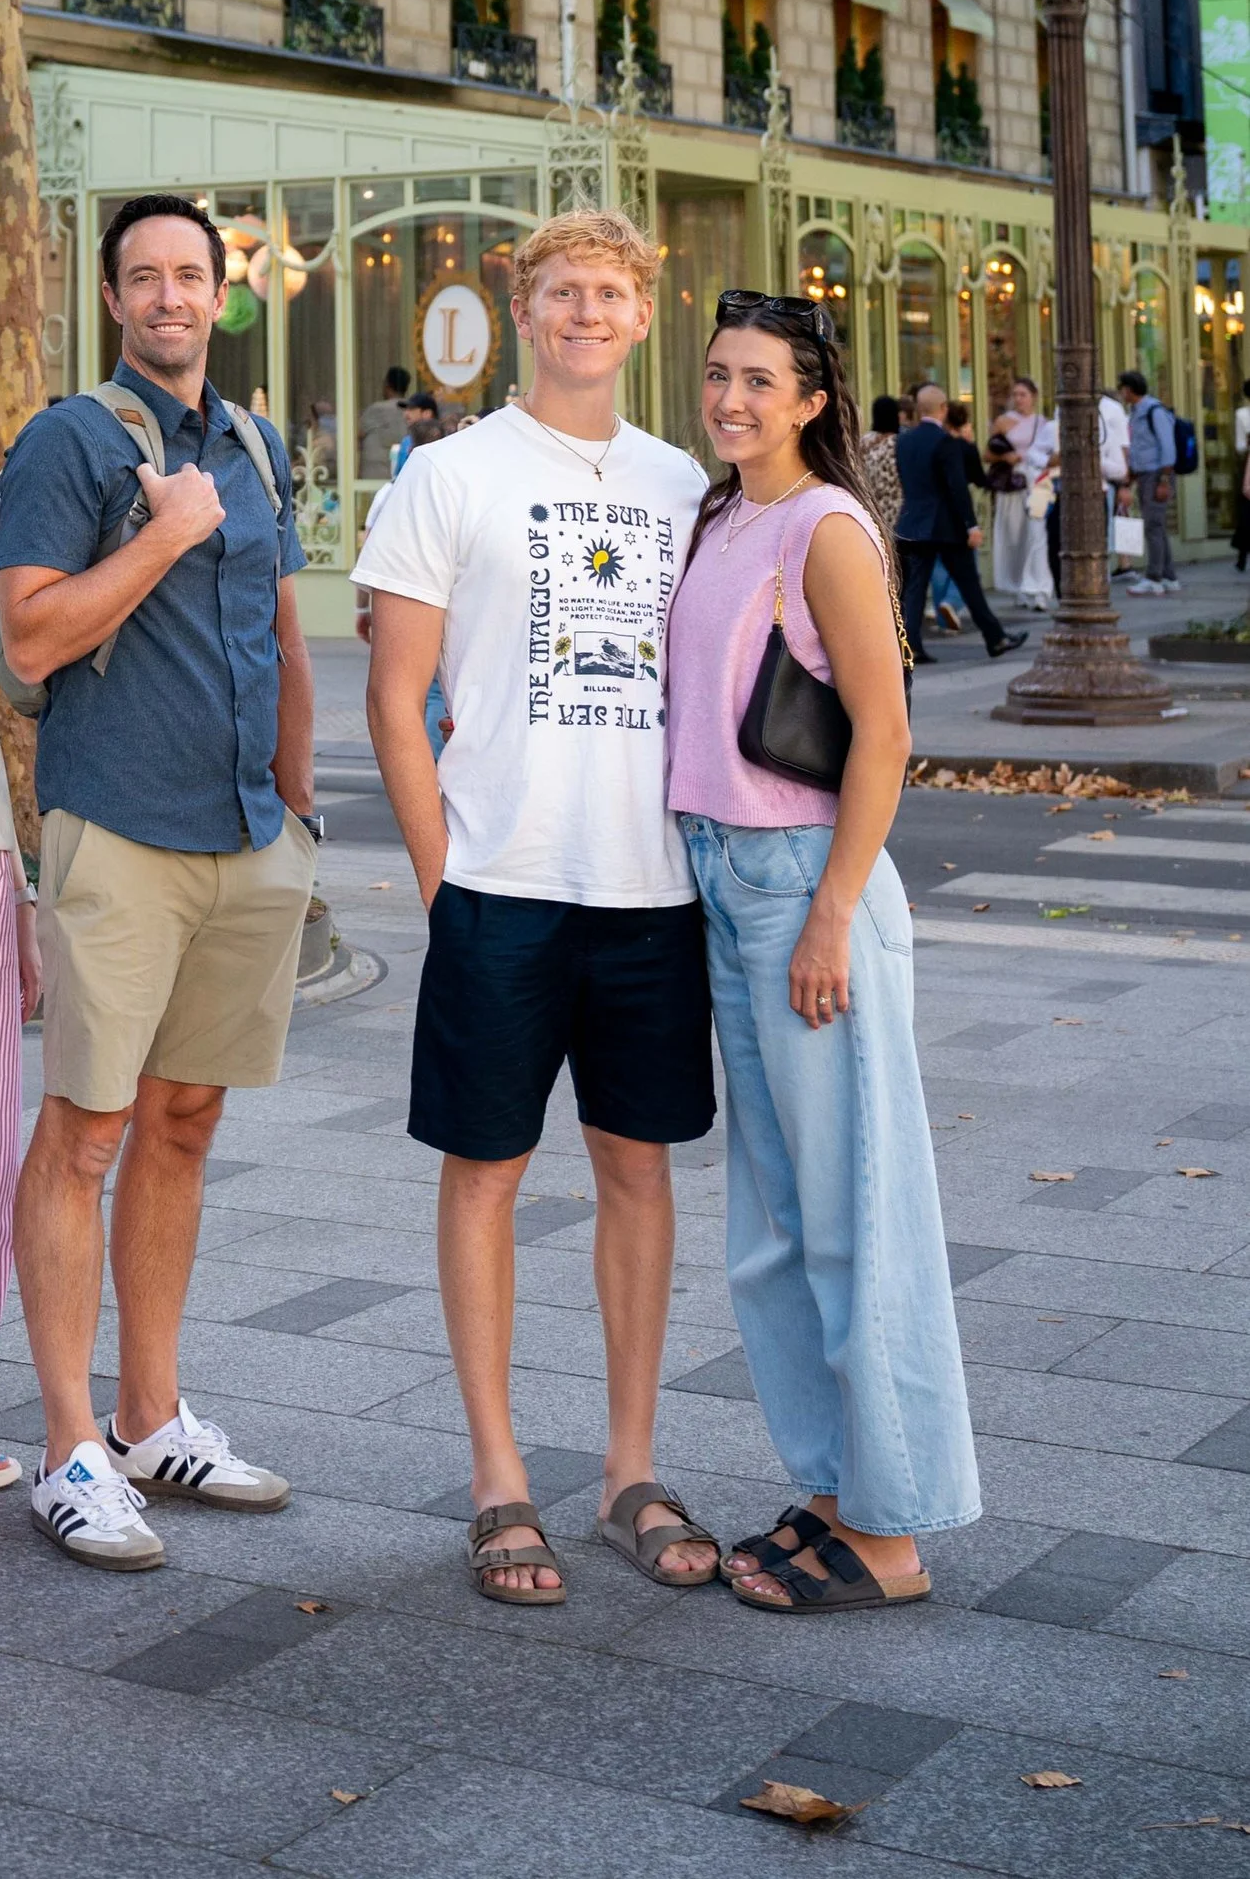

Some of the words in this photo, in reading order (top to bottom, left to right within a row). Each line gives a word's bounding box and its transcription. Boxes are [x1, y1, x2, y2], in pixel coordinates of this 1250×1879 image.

[437, 307, 477, 366] L
[553, 502, 599, 526] THE
[606, 504, 651, 529] SUN
[528, 527, 549, 560] OF
[655, 517, 674, 564] THE
[529, 568, 551, 664] MAGIC
[529, 673, 552, 725] THE
[558, 704, 607, 726] SEA
